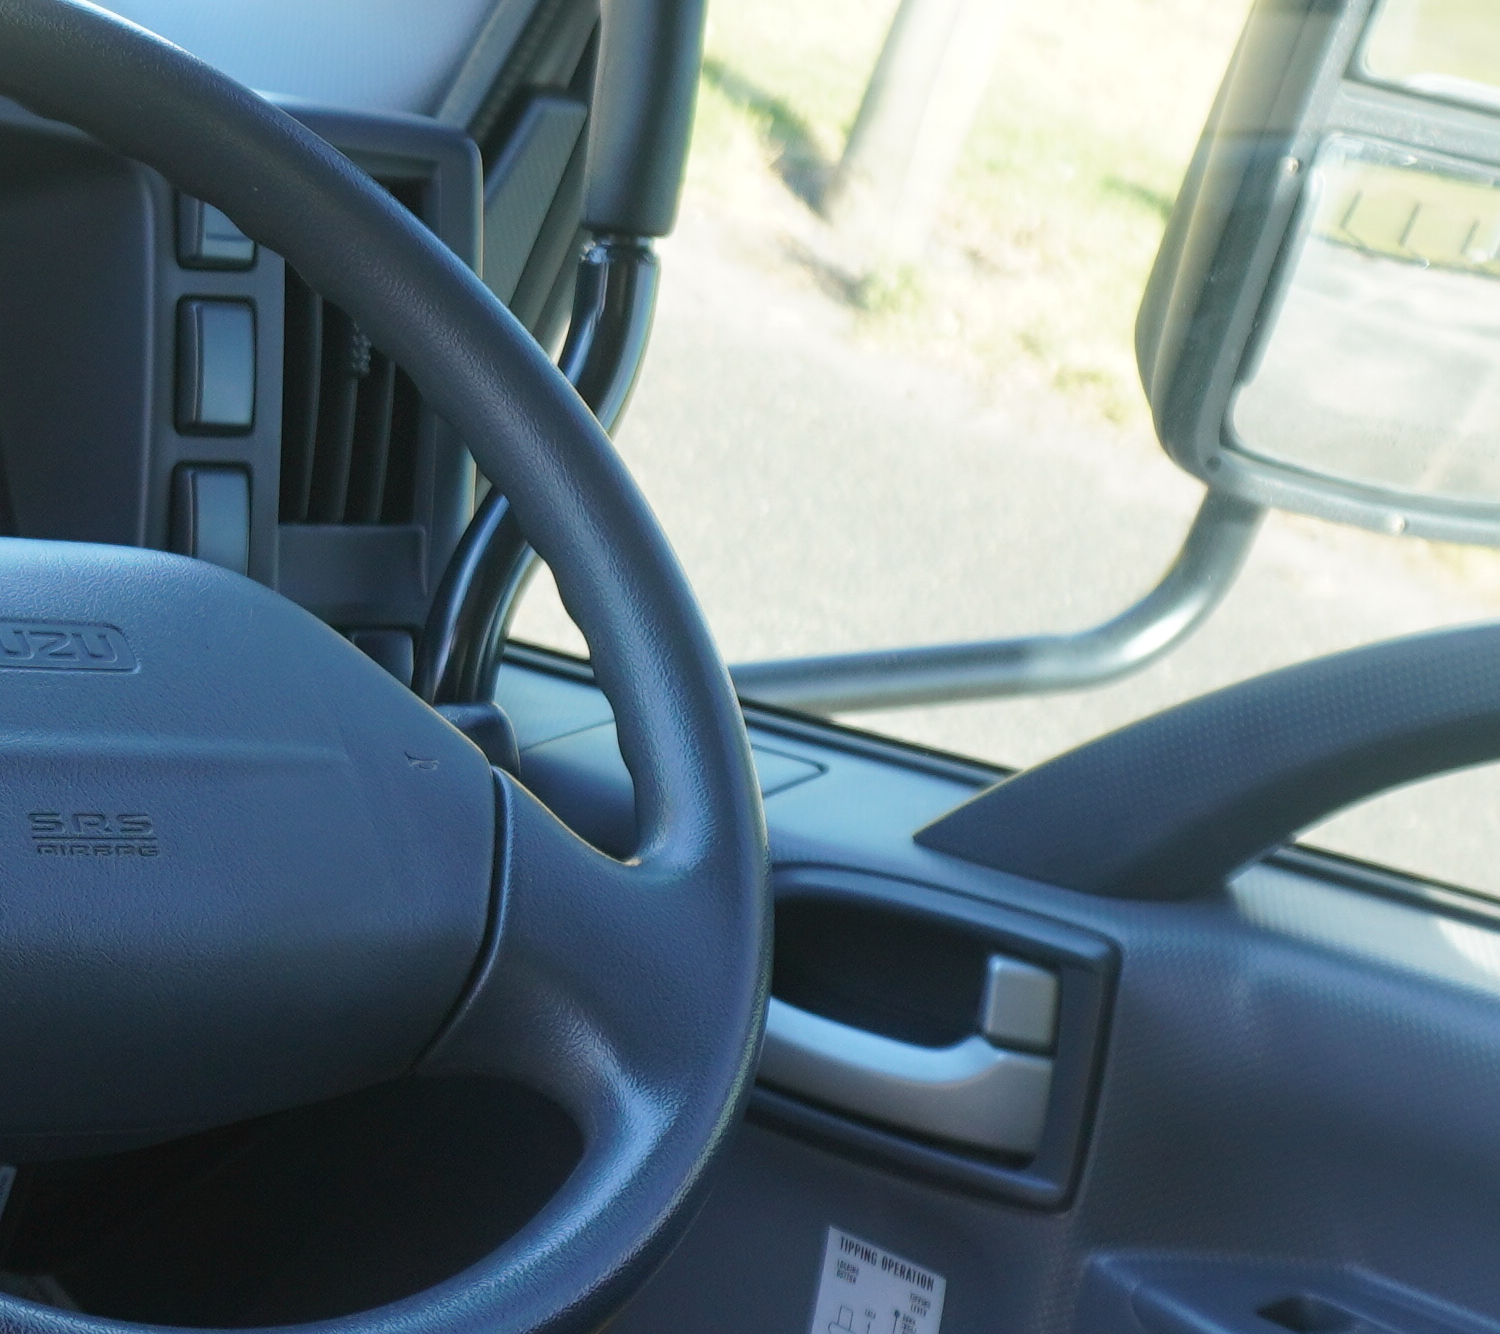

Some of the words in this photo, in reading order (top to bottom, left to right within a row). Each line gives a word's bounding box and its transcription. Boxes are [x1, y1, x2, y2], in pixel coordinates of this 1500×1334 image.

[36, 843, 160, 859] AIRBAG
[840, 1236, 878, 1266] TIPPING
[881, 1255, 935, 1293] OPERATION
